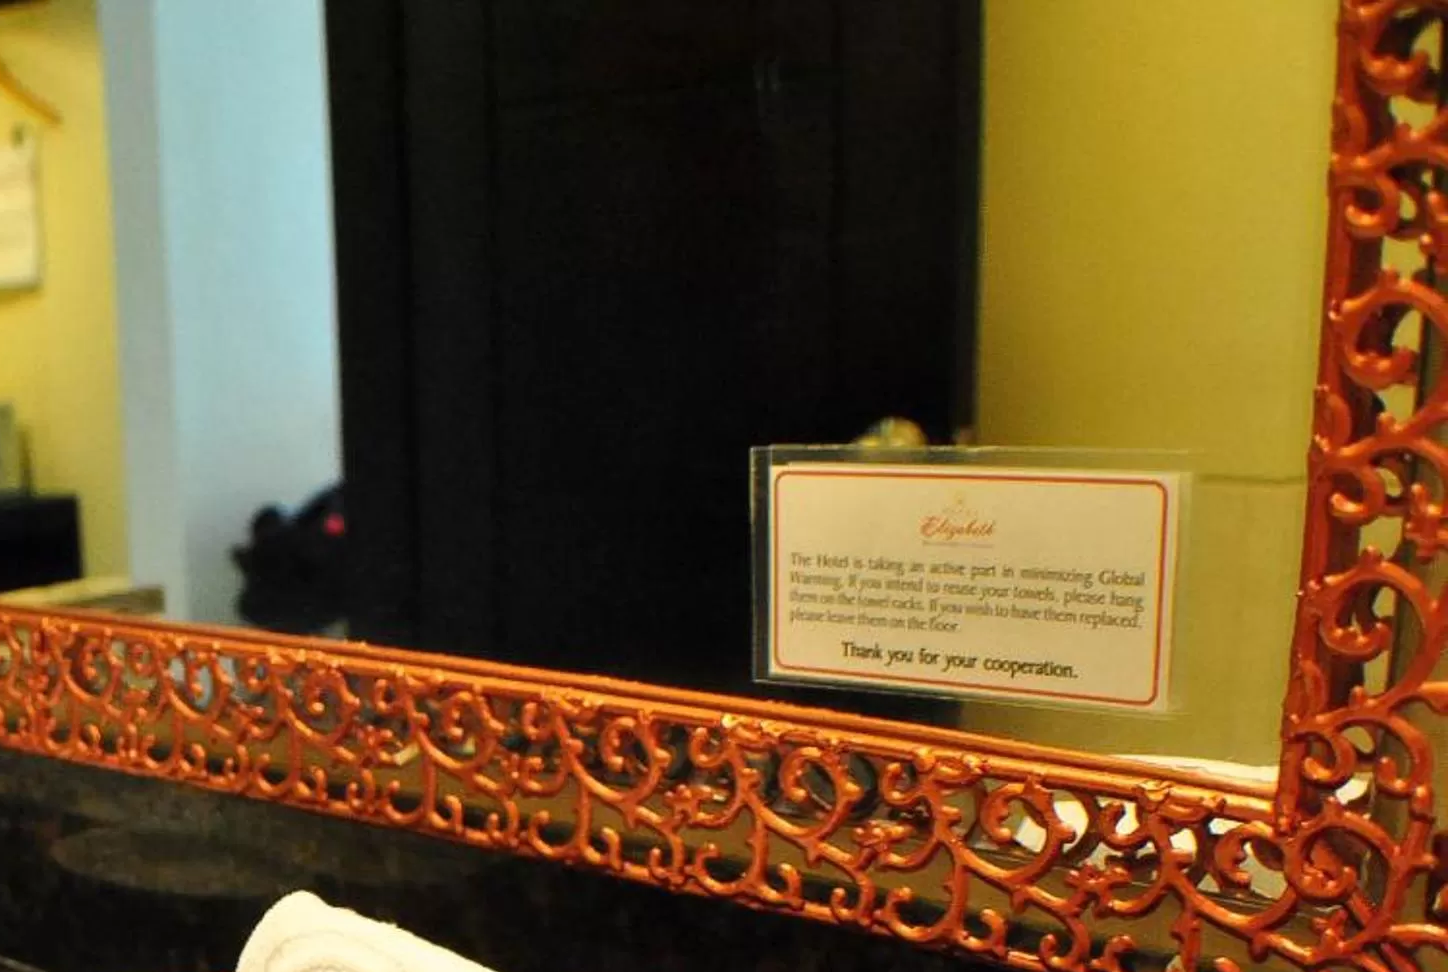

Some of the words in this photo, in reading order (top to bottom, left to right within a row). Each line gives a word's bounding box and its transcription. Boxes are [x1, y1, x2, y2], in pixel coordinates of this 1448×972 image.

[791, 552, 812, 567] The
[816, 554, 849, 569] Hotel
[853, 557, 864, 569] is
[868, 557, 905, 576] taking
[930, 561, 965, 575] active
[970, 565, 997, 580] part
[1002, 565, 1014, 577] in
[1020, 567, 1094, 589] minimizing
[1098, 569, 1146, 587] Global
[858, 578, 882, 592] you
[927, 581, 940, 593] to
[981, 585, 1010, 602] your
[1064, 589, 1105, 608] please
[1110, 592, 1145, 613] hang
[940, 601, 963, 617] you
[965, 602, 993, 617] wish
[995, 604, 1009, 618] to
[1011, 605, 1043, 621] have
[1044, 607, 1077, 623] them
[841, 640, 883, 658] Thank
[885, 650, 913, 667] you
[918, 648, 940, 665] for
[942, 654, 978, 673] your
[983, 657, 1079, 679] cooperation.
